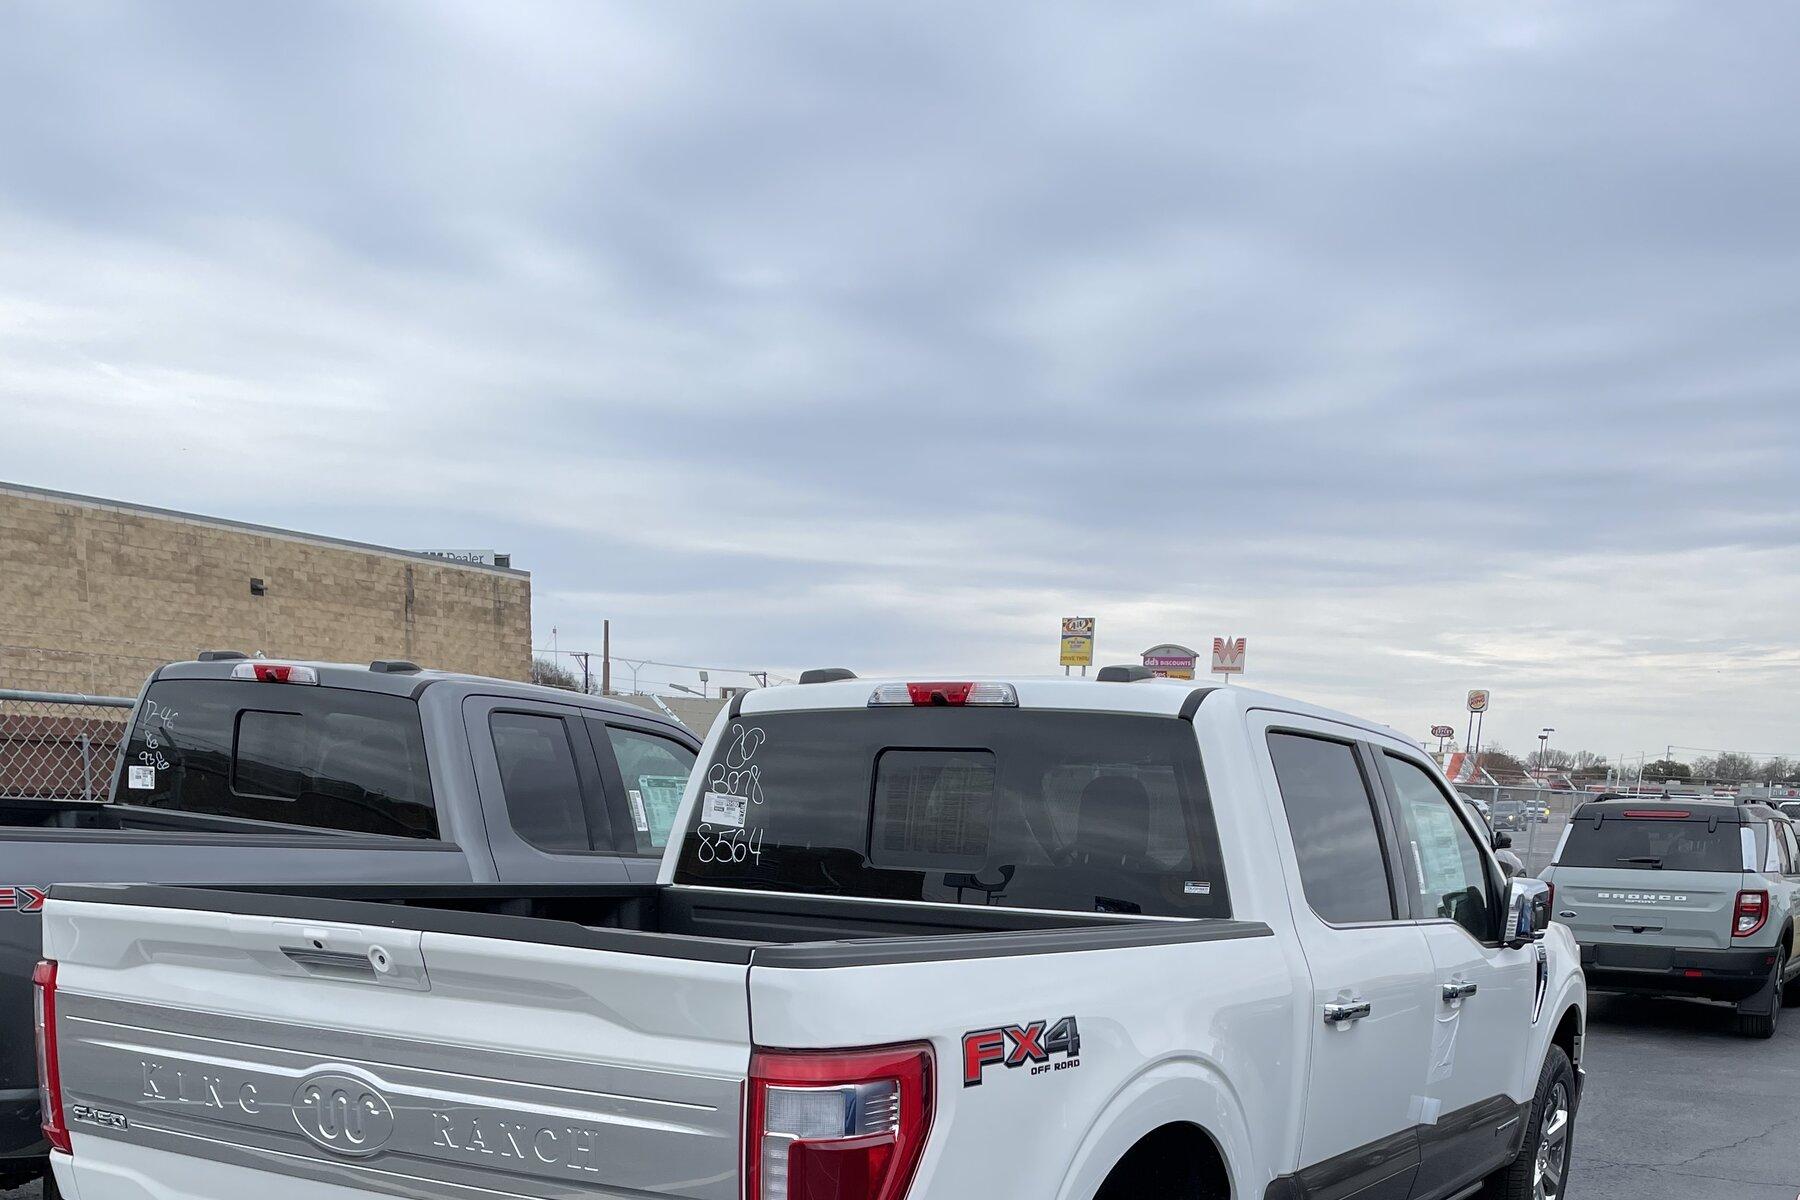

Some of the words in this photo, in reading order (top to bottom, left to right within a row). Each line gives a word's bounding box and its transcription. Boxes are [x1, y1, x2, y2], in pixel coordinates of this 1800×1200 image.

[697, 823, 764, 866] 8564
[1597, 892, 1687, 901] BRONCO
[961, 1015, 1081, 1088] FX4
[1030, 1064, 1051, 1076] OFF
[1054, 1059, 1080, 1071] ROAD
[140, 1061, 260, 1114] KING
[432, 1111, 599, 1171] RANCH
